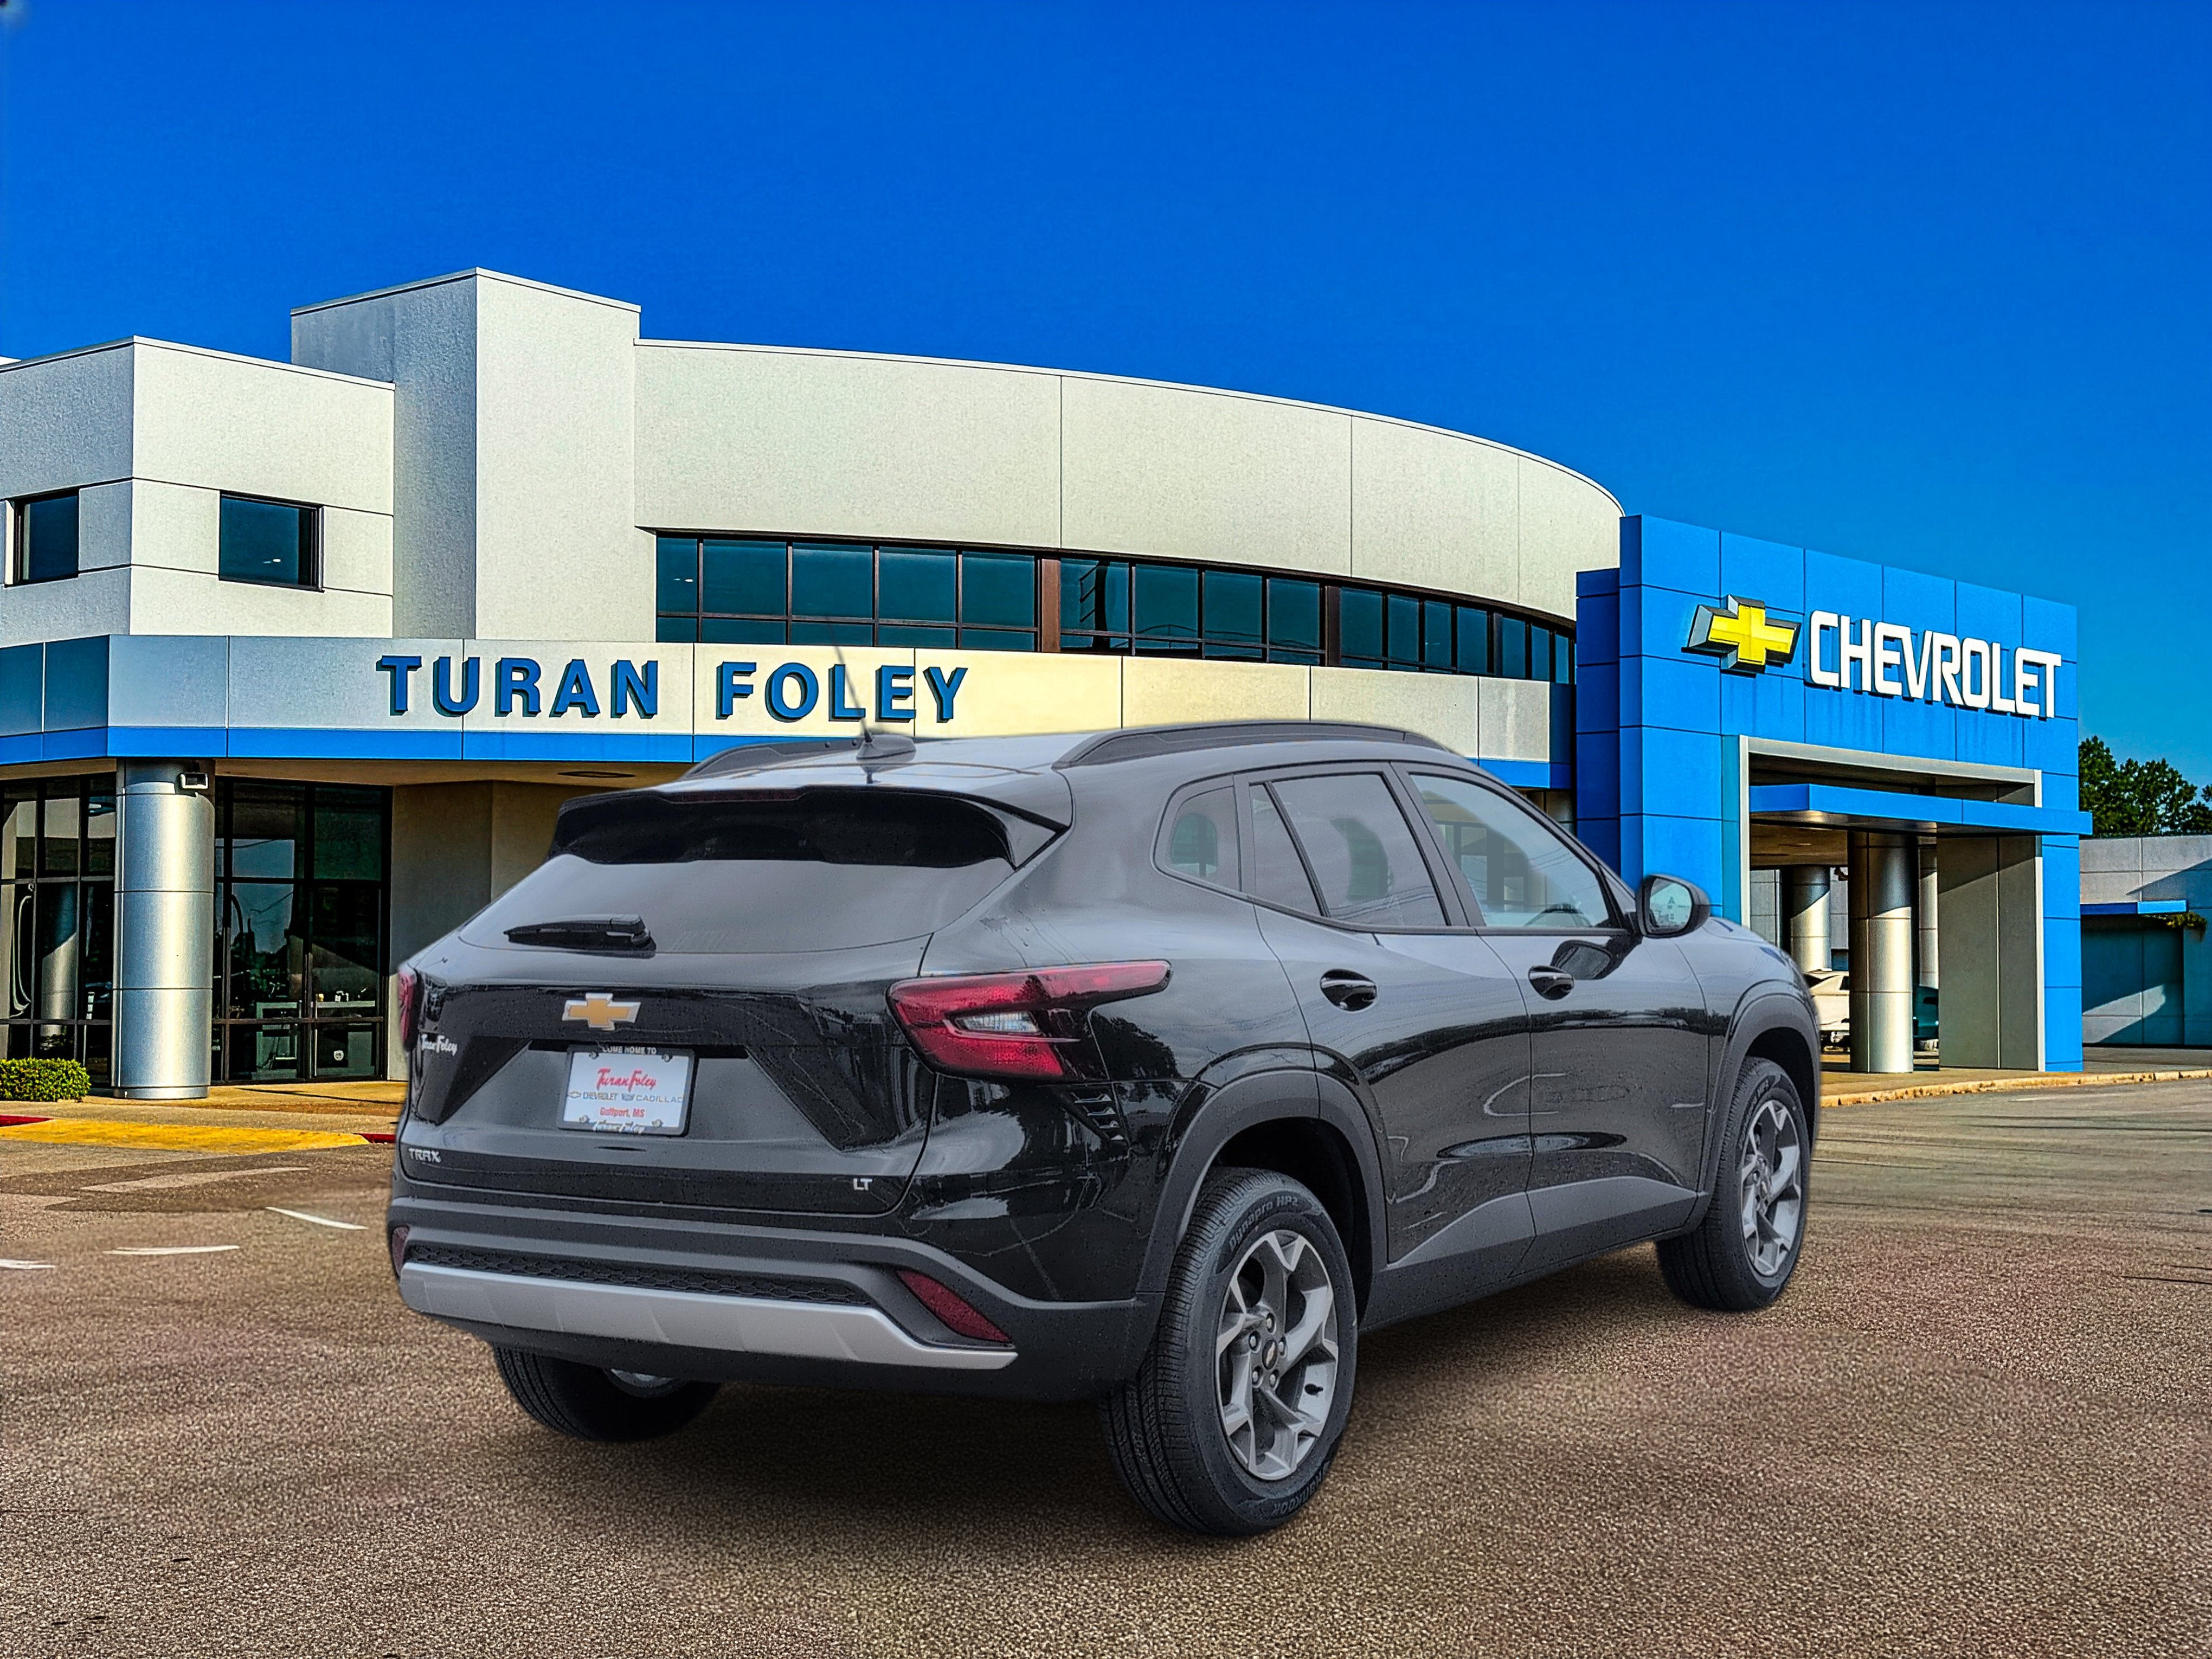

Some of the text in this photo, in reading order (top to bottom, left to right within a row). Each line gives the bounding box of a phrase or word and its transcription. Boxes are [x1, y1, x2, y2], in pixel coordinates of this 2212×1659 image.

[1810, 610, 2062, 718] CHEVROLET
[377, 654, 968, 723] TURAN FOLEY
[636, 1095, 683, 1103] CADILLAC
[632, 1108, 645, 1117] MS
[408, 1148, 442, 1163] TRAX
[853, 1178, 873, 1191] LT
